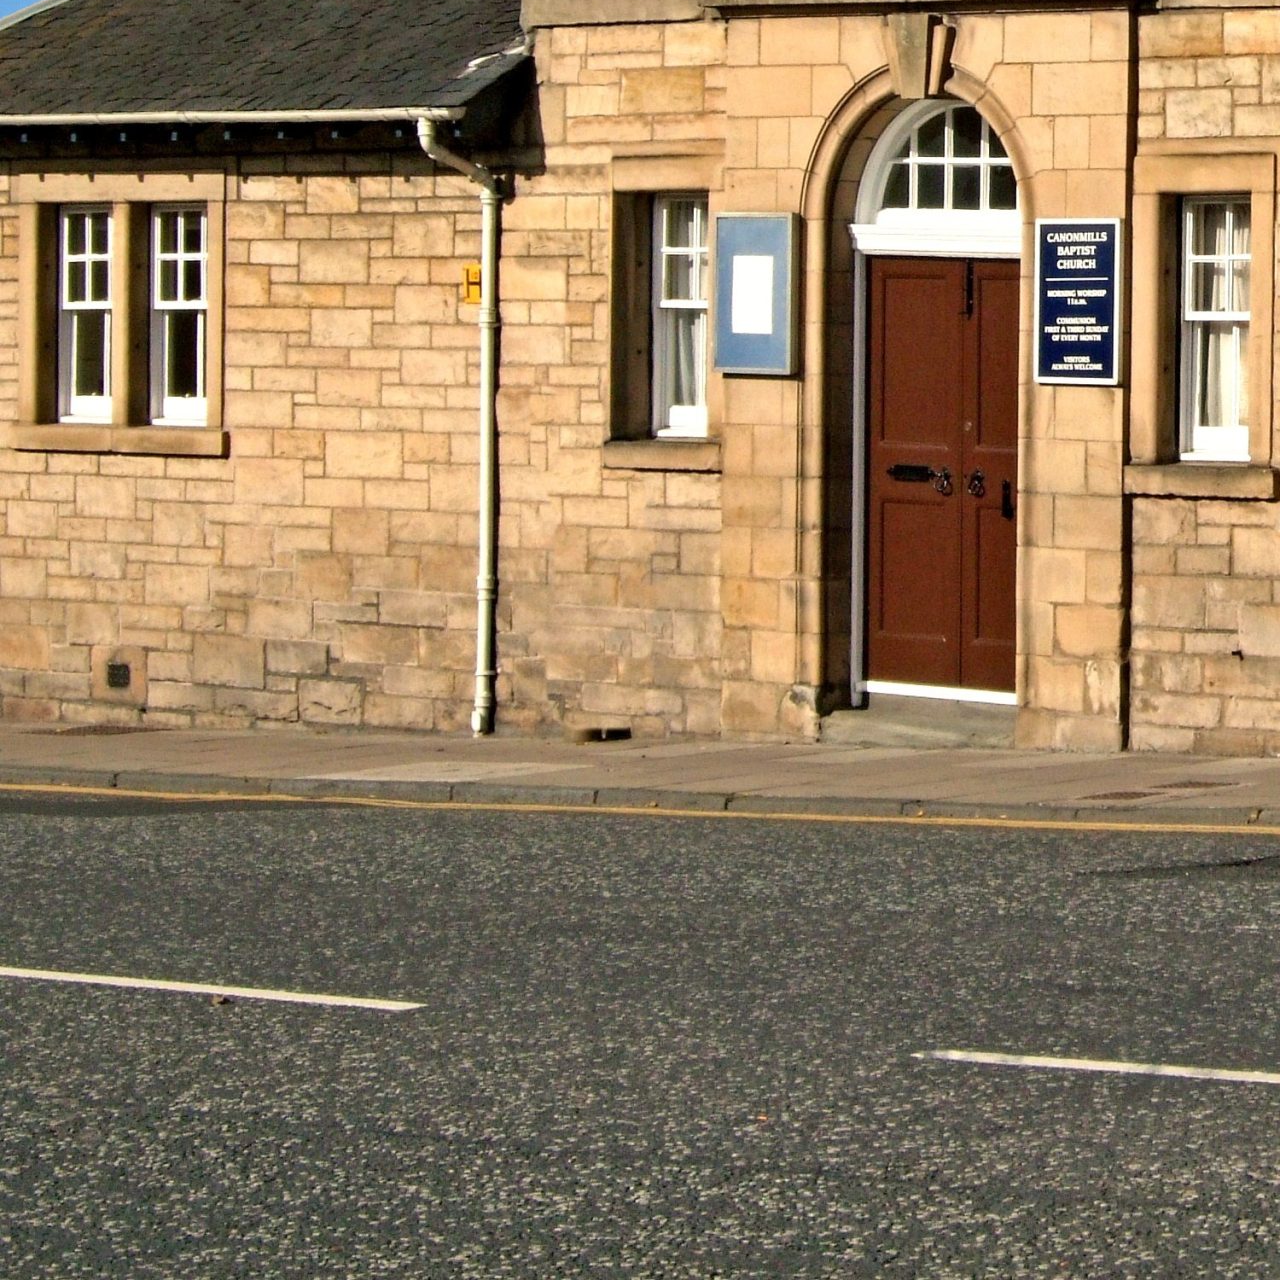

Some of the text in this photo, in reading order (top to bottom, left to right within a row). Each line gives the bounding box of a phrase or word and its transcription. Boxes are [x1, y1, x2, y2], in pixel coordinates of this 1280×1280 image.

[1046, 231, 1108, 243] CANONMILLS
[1056, 245, 1097, 256] BAPTIST
[1056, 258, 1097, 270] CHURCH
